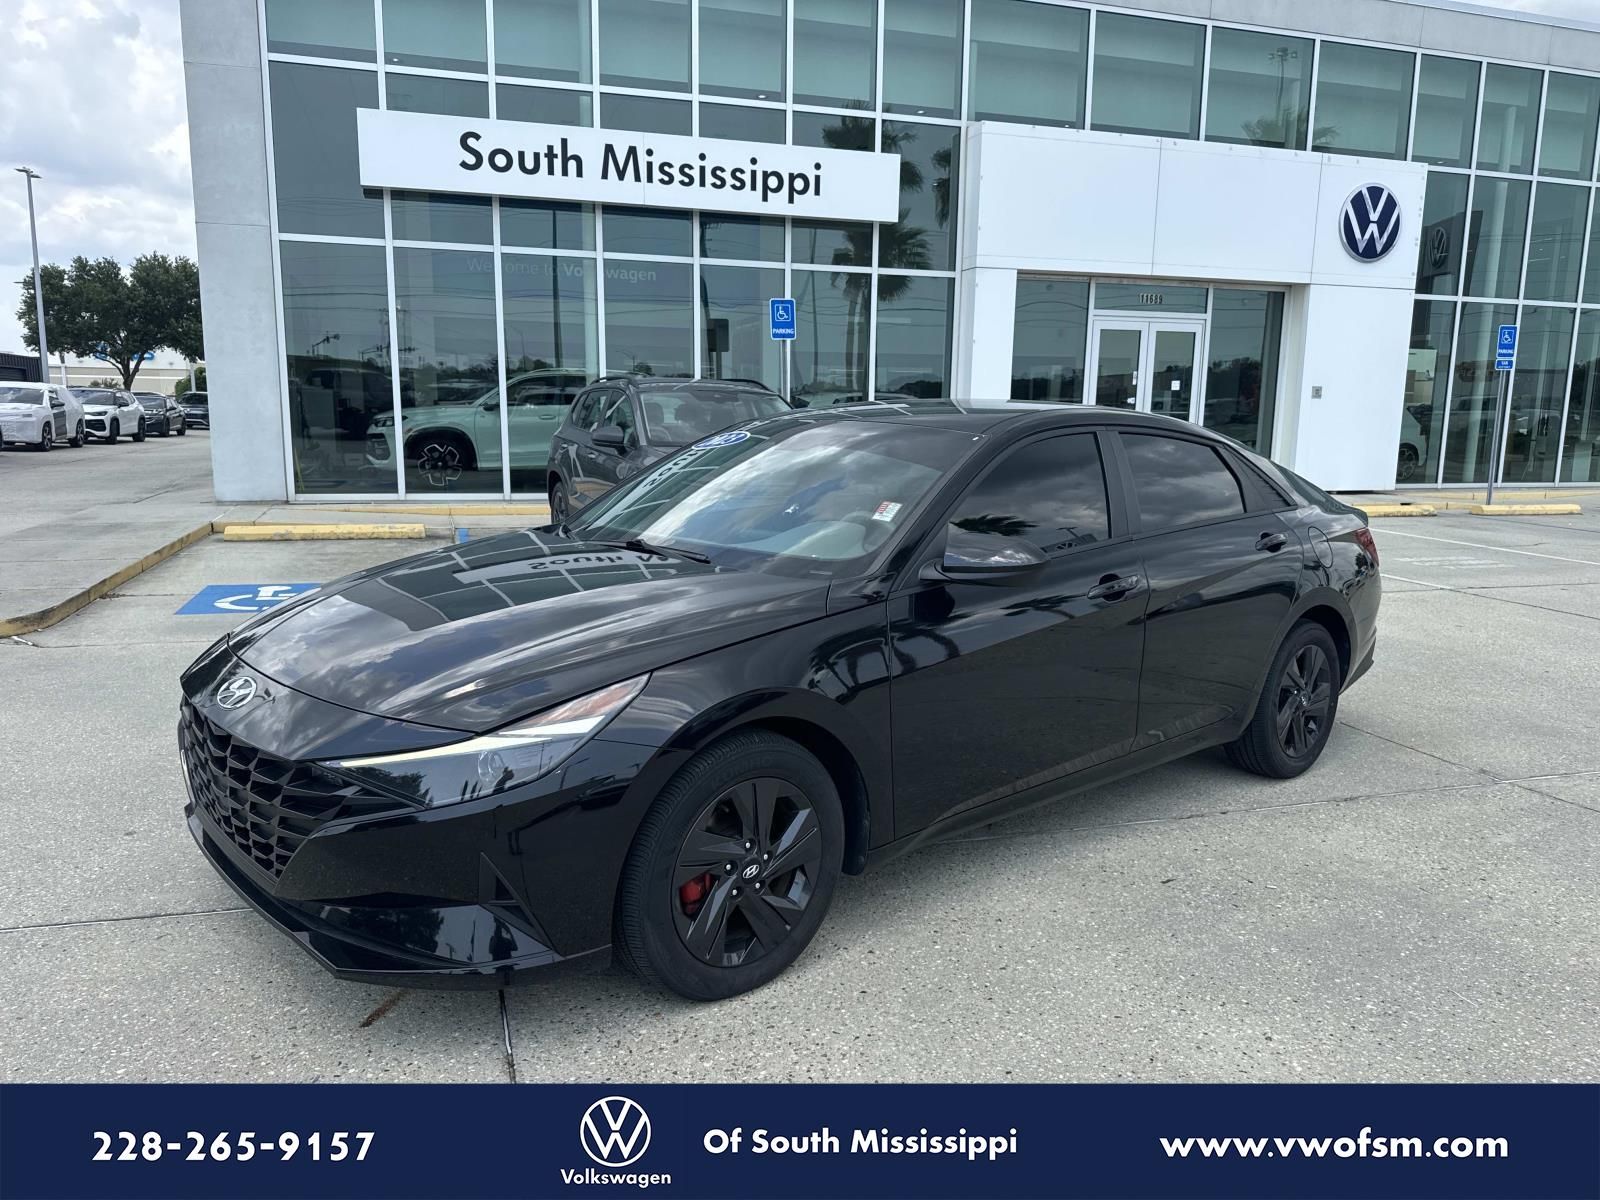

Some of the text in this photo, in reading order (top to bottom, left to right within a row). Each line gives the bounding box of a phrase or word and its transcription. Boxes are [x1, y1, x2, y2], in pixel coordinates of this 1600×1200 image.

[459, 131, 823, 204] South Mississippi
[467, 257, 539, 276] Weome
[562, 263, 657, 284] Vowagen
